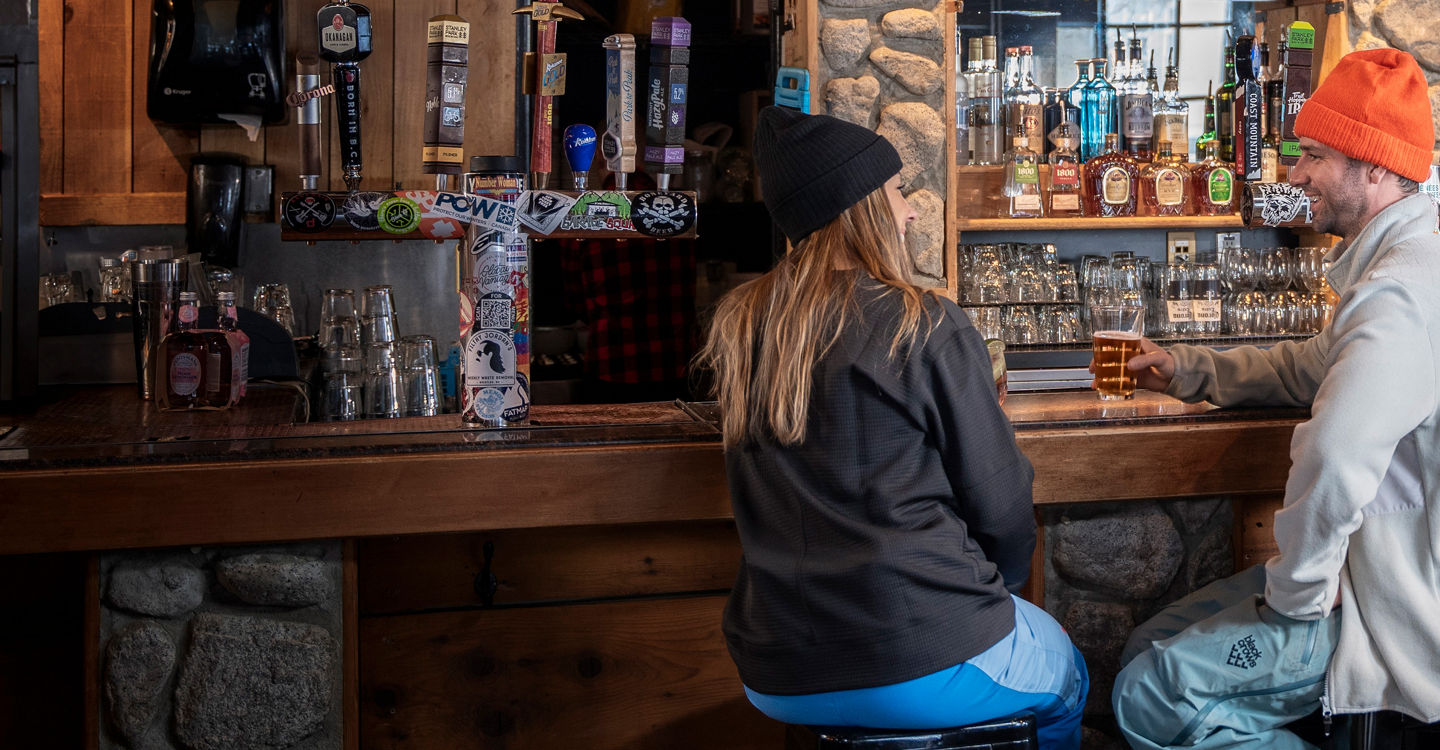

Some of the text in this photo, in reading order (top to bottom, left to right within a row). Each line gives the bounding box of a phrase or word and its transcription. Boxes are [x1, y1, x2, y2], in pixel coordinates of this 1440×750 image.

[325, 32, 353, 41] OKANAGAN
[286, 84, 336, 108] Corona
[347, 85, 358, 162] BORN IN B.C.
[1250, 122, 1258, 168] MOUNTAIN
[1017, 167, 1034, 175] 1800
[1056, 169, 1075, 177] 1800
[433, 207, 455, 217] PROTECT
[435, 193, 499, 220] POW
[606, 217, 637, 230] SQUA
[469, 332, 513, 352] FILTHY JORDAN'S
[504, 405, 528, 417] FATMAP
[1237, 639, 1257, 668] crows
[1244, 634, 1262, 660] black
